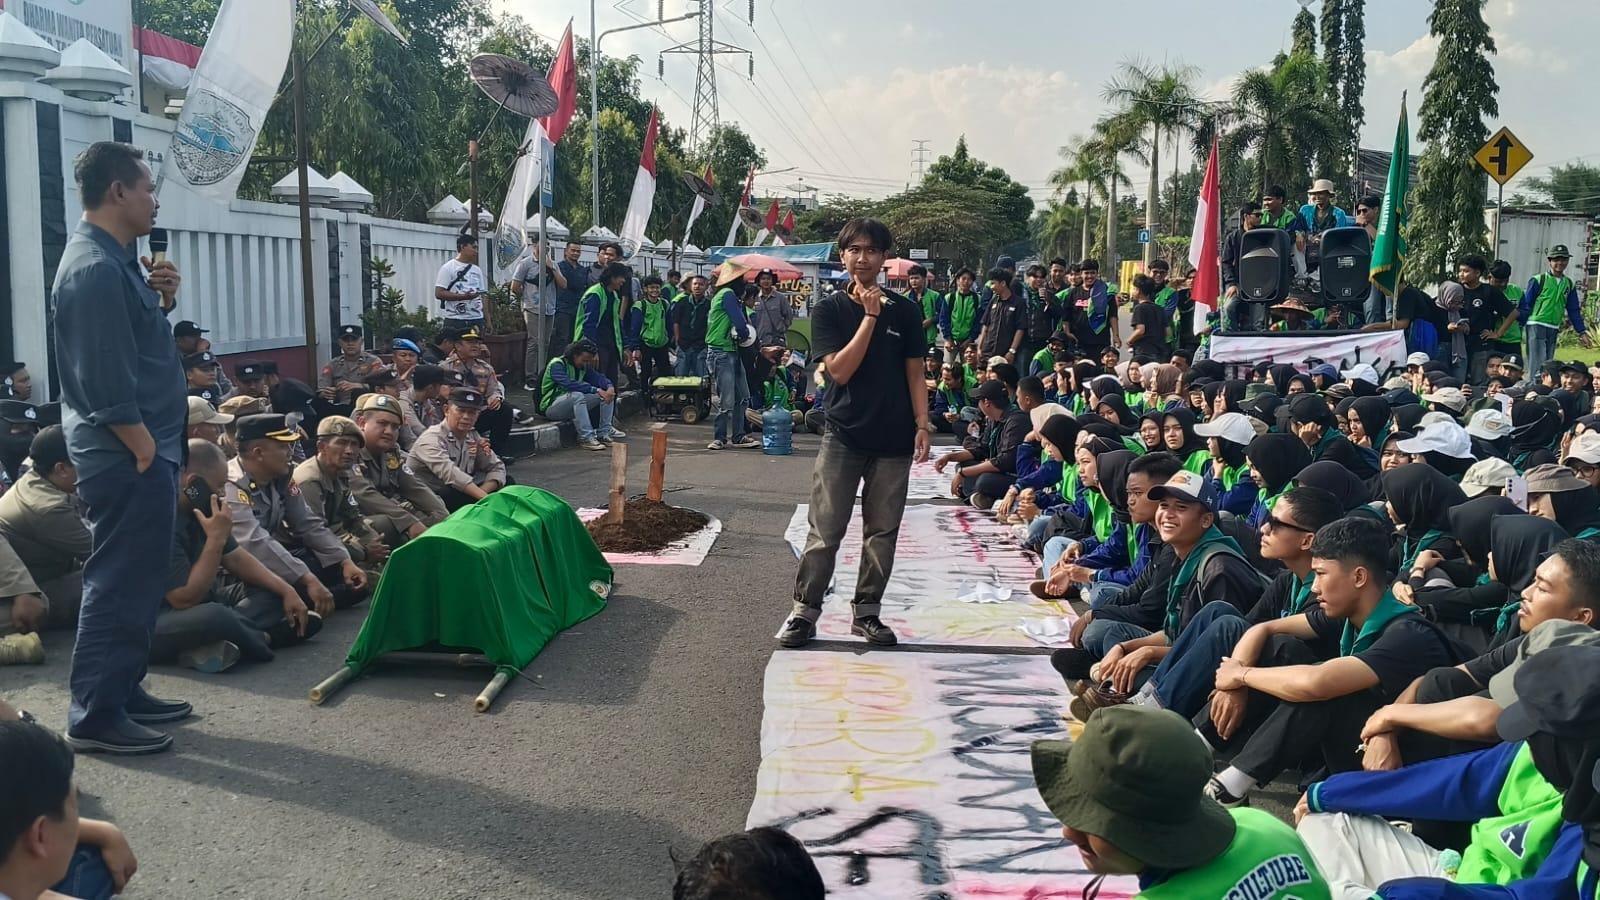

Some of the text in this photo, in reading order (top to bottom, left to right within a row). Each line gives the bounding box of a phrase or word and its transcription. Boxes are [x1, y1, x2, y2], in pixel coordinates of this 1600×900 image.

[23, 1, 57, 36] DHARMA
[56, 12, 84, 42] WANITA
[85, 22, 123, 58] PERSATUAN
